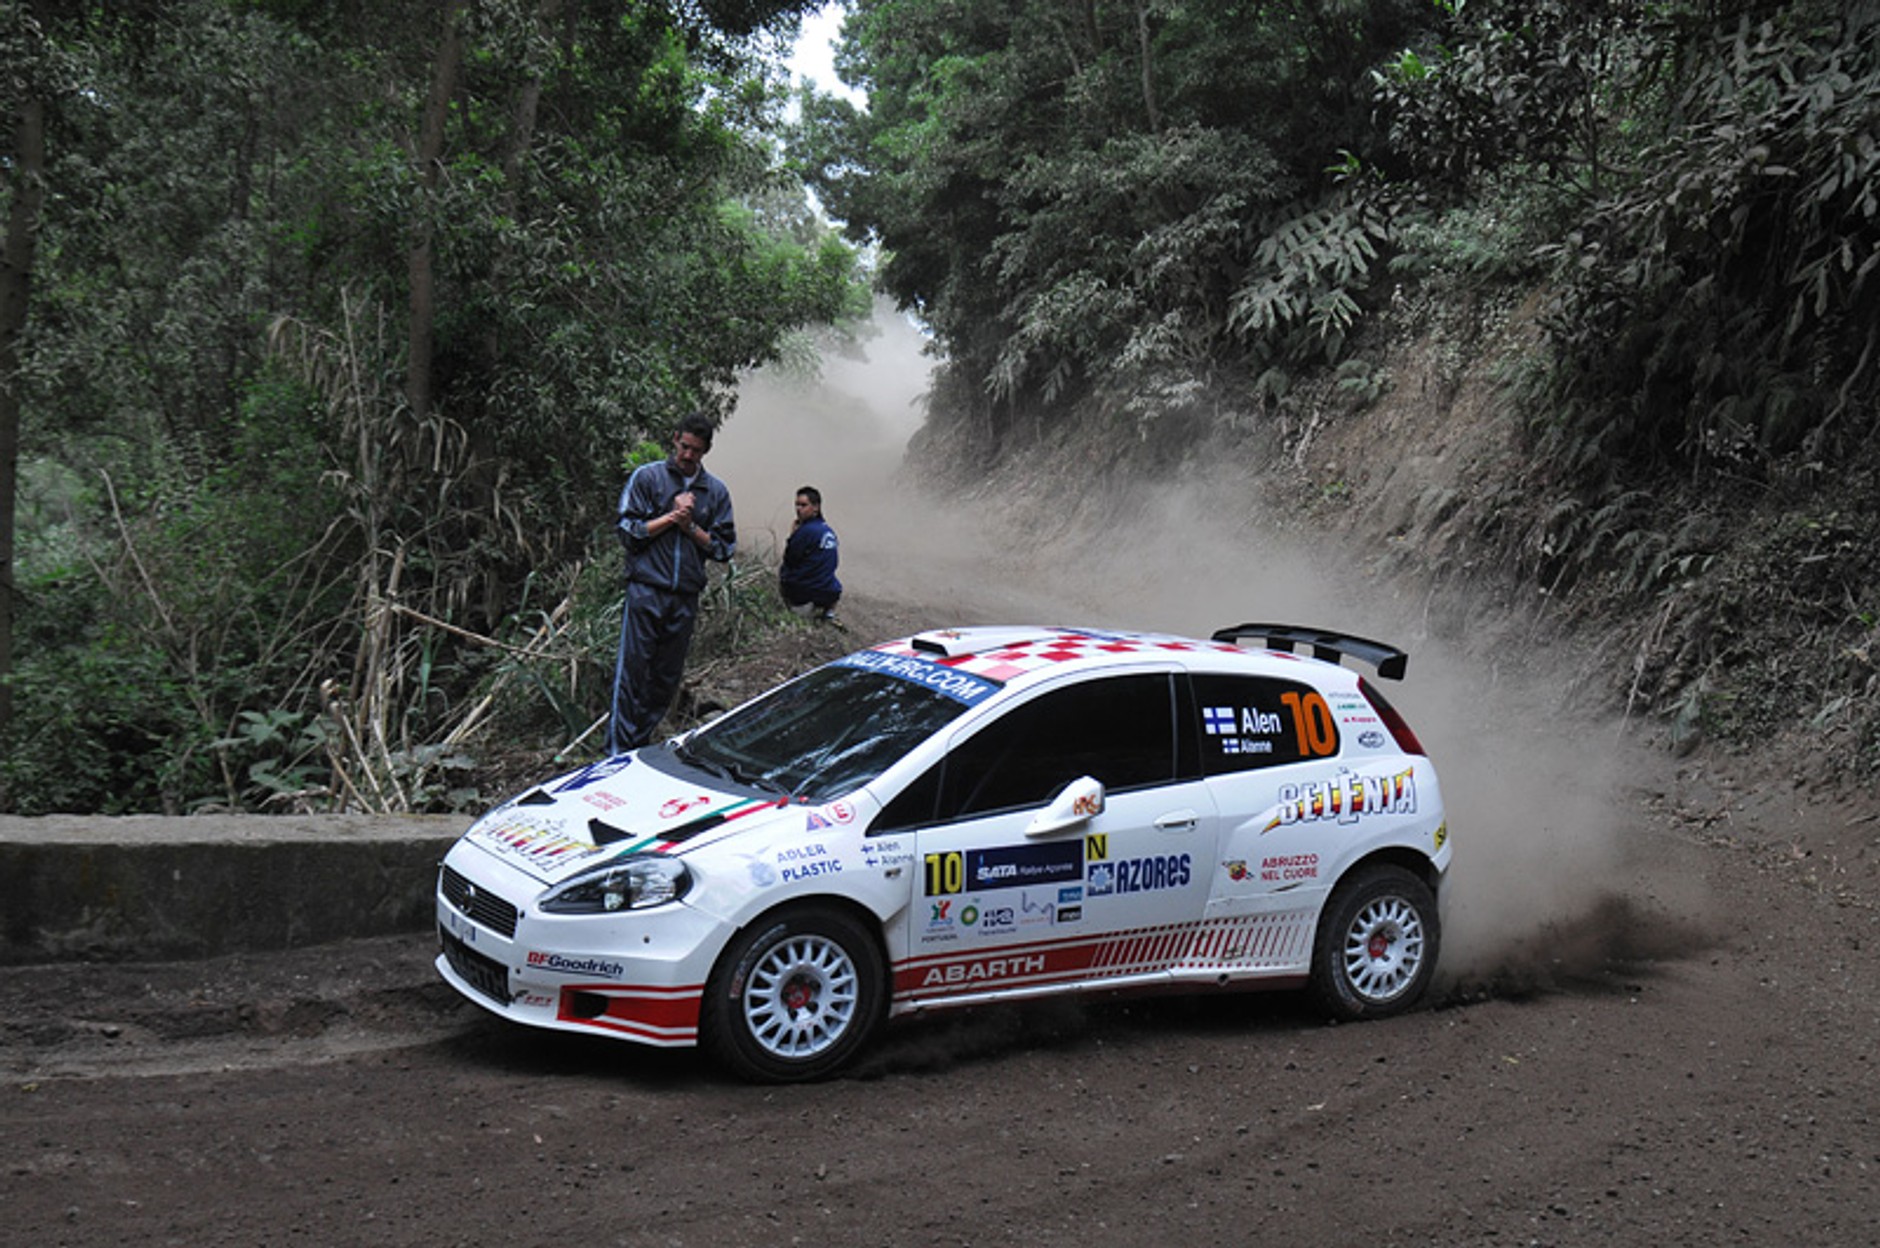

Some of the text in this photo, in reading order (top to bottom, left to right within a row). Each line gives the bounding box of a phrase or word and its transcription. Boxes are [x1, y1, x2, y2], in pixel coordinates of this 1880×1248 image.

[1242, 707, 1282, 734] Alen
[1281, 692, 1337, 756] 10
[777, 843, 827, 863] ADLER
[1087, 835, 1107, 859] N
[782, 859, 842, 882] PLASTIC
[926, 852, 962, 896] 10
[1116, 854, 1191, 894] AZORES
[1261, 867, 1318, 881] NEL CUORE
[1262, 854, 1319, 869] ABRUZZO
[527, 951, 624, 976] BFGoodrich
[923, 955, 1046, 986] ABARTH
